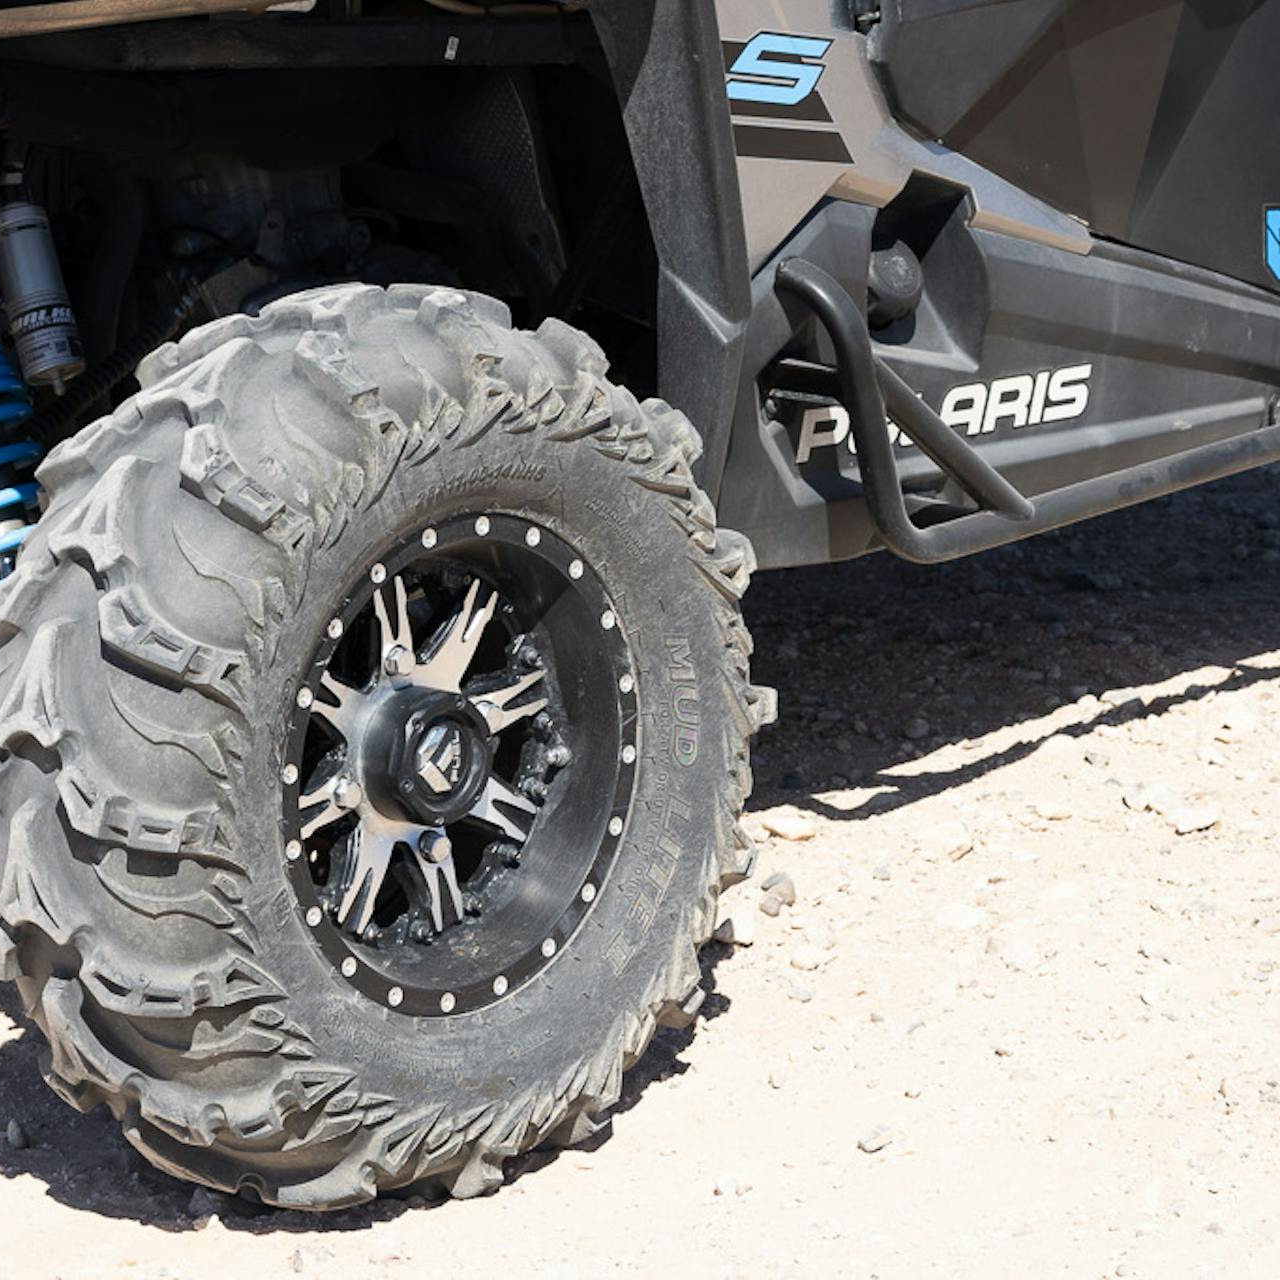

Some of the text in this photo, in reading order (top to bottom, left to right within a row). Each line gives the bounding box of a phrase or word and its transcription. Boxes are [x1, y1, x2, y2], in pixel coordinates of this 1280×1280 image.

[725, 31, 835, 106] S
[795, 363, 1093, 464] PARIS
[664, 634, 701, 769] MUD
[627, 793, 692, 936] LITE
